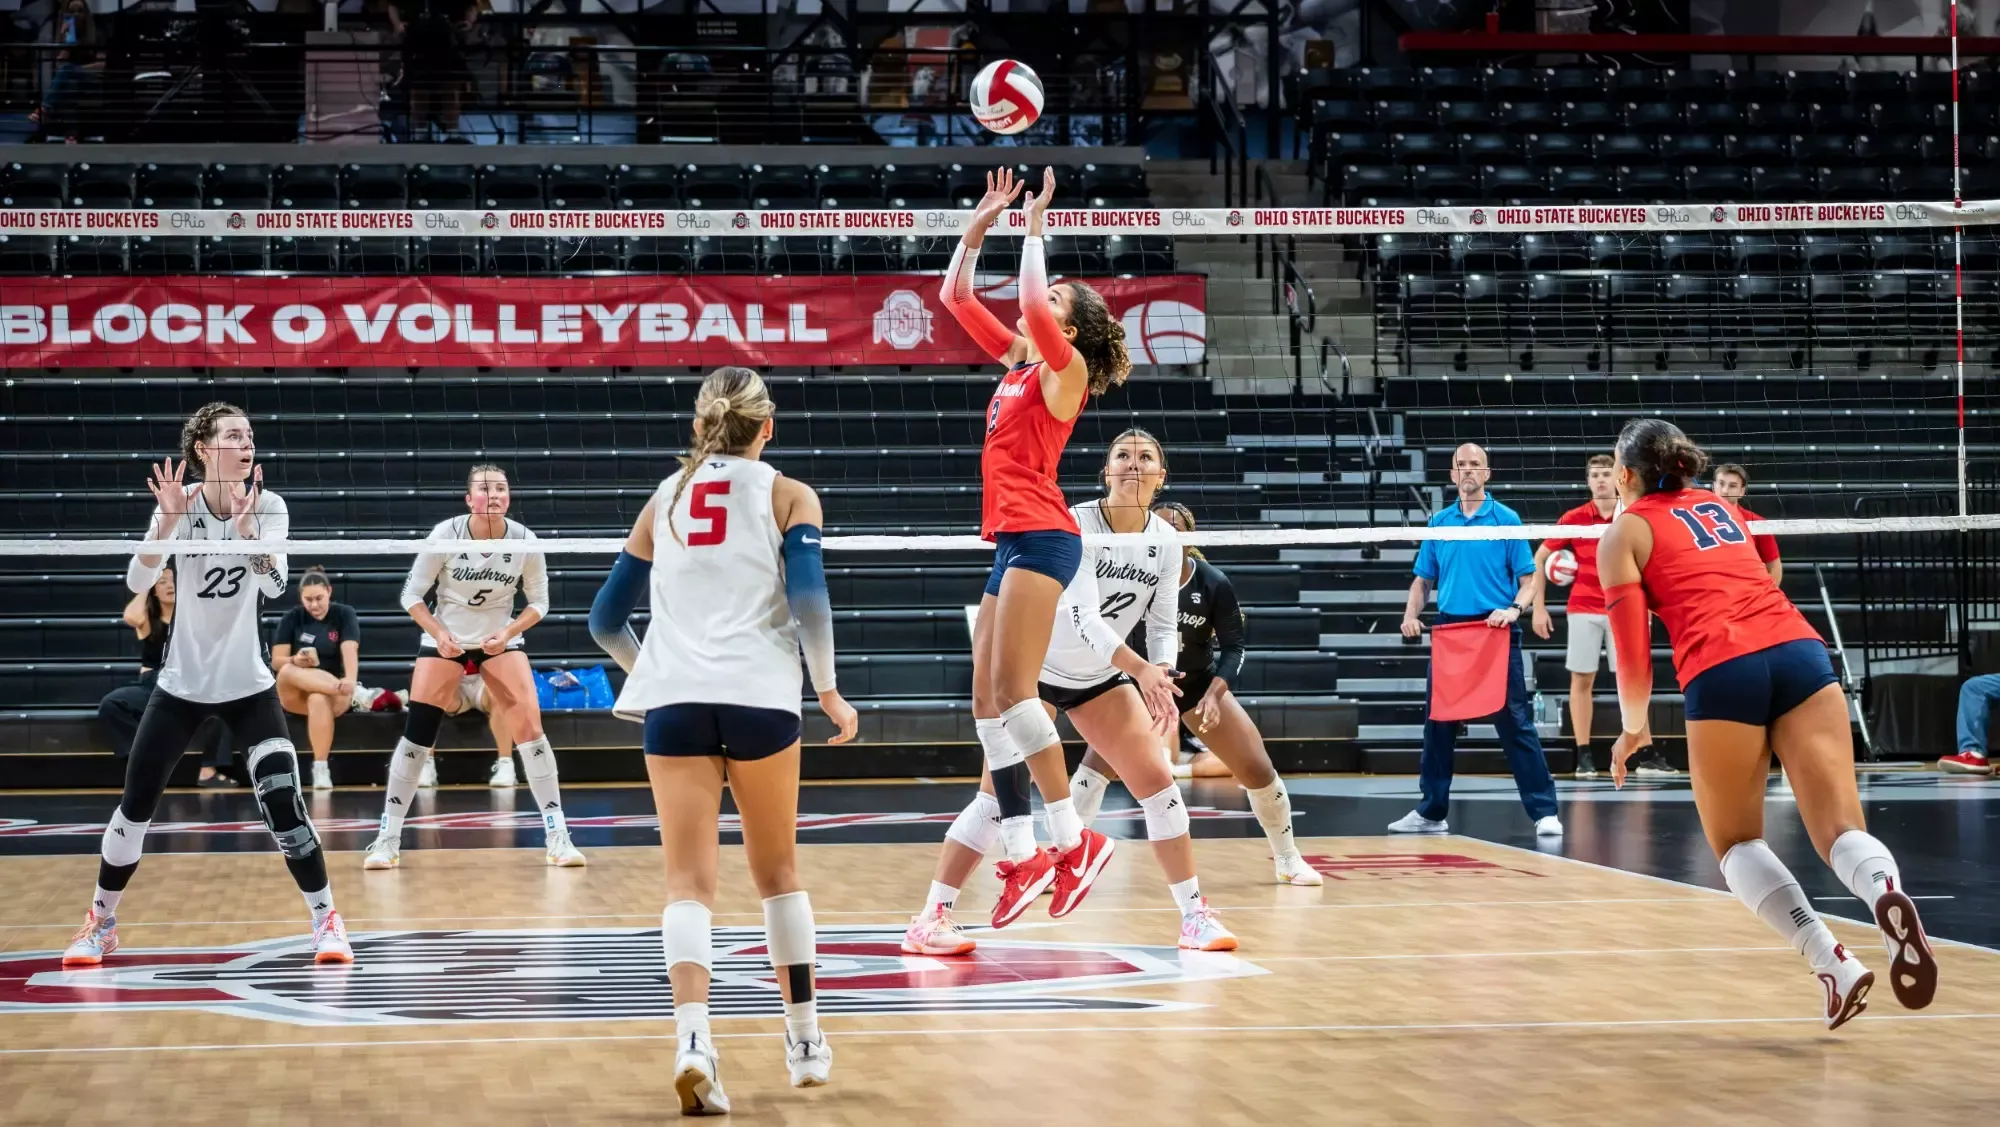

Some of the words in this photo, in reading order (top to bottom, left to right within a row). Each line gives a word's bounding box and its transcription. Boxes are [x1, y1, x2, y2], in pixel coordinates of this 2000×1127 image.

[0, 212, 35, 228] OHIO
[40, 212, 81, 228] STATE
[87, 212, 158, 228] BUCKEYES
[171, 212, 205, 228] Ohio
[256, 212, 290, 228] OHIO
[296, 212, 337, 228] STATE
[342, 212, 413, 228] BUCKEYES
[425, 212, 459, 228] Ohio
[509, 213, 544, 228] OHIO
[549, 213, 589, 228] STATE
[595, 213, 665, 228] BUCKEYES
[677, 212, 710, 228] Ohio
[760, 212, 795, 228] OHIO
[799, 212, 839, 228] STATE
[844, 212, 913, 228] BUCKEYES
[926, 212, 960, 227] Ohio
[1009, 212, 1026, 227] OH
[1047, 211, 1087, 227] STATE
[1092, 211, 1160, 227] BUCKEYES
[1172, 210, 1205, 225] Ohio
[1254, 210, 1288, 226] OHIO
[1291, 210, 1331, 226] STATE
[1336, 210, 1405, 226] BUCKEYES
[1416, 209, 1449, 224] Ohio
[1497, 208, 1531, 225] OHIO
[1535, 208, 1574, 225] STATE
[1579, 208, 1646, 225] BUCKEYES
[1657, 206, 1689, 221] Ohio
[1737, 207, 1770, 222] OHIO
[1775, 206, 1812, 221] STATE
[1818, 205, 1884, 221] BUCKEYES
[1896, 204, 1928, 219] Ohio
[0, 303, 256, 344] BLOCK
[272, 303, 326, 344] O
[342, 303, 828, 344] VOLLEYBALL
[988, 399, 1001, 435] 2
[687, 480, 731, 547] 5
[1670, 501, 1747, 551] 13
[197, 566, 247, 599] 23
[452, 567, 516, 586] Winthrop
[1096, 559, 1159, 588] Winthrop
[467, 589, 493, 606] 5
[1099, 591, 1137, 620] 12
